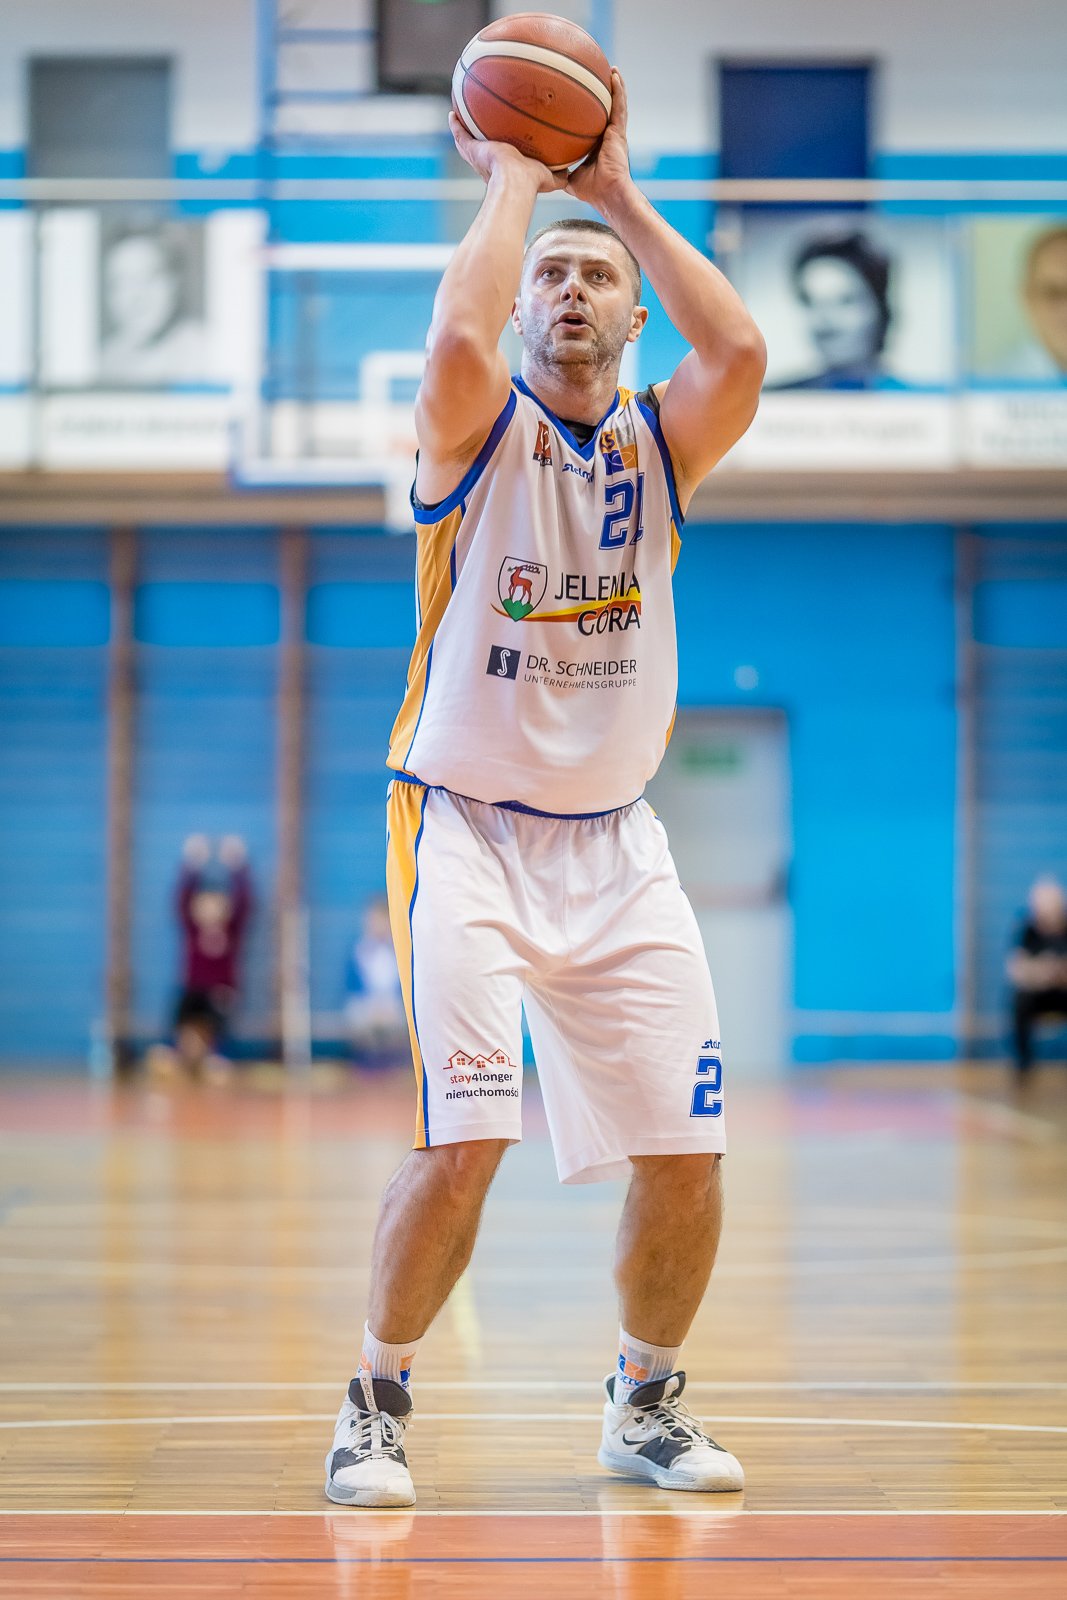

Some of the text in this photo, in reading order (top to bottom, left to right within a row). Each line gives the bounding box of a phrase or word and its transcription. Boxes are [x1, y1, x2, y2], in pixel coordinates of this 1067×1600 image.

[554, 571, 641, 601] JELENIA
[577, 602, 641, 637] GÓRA
[526, 655, 637, 677] DR. SCHNEIDER
[524, 674, 637, 690] UNTERNEHMENSGRUPPE
[450, 1072, 513, 1084] stay4longer
